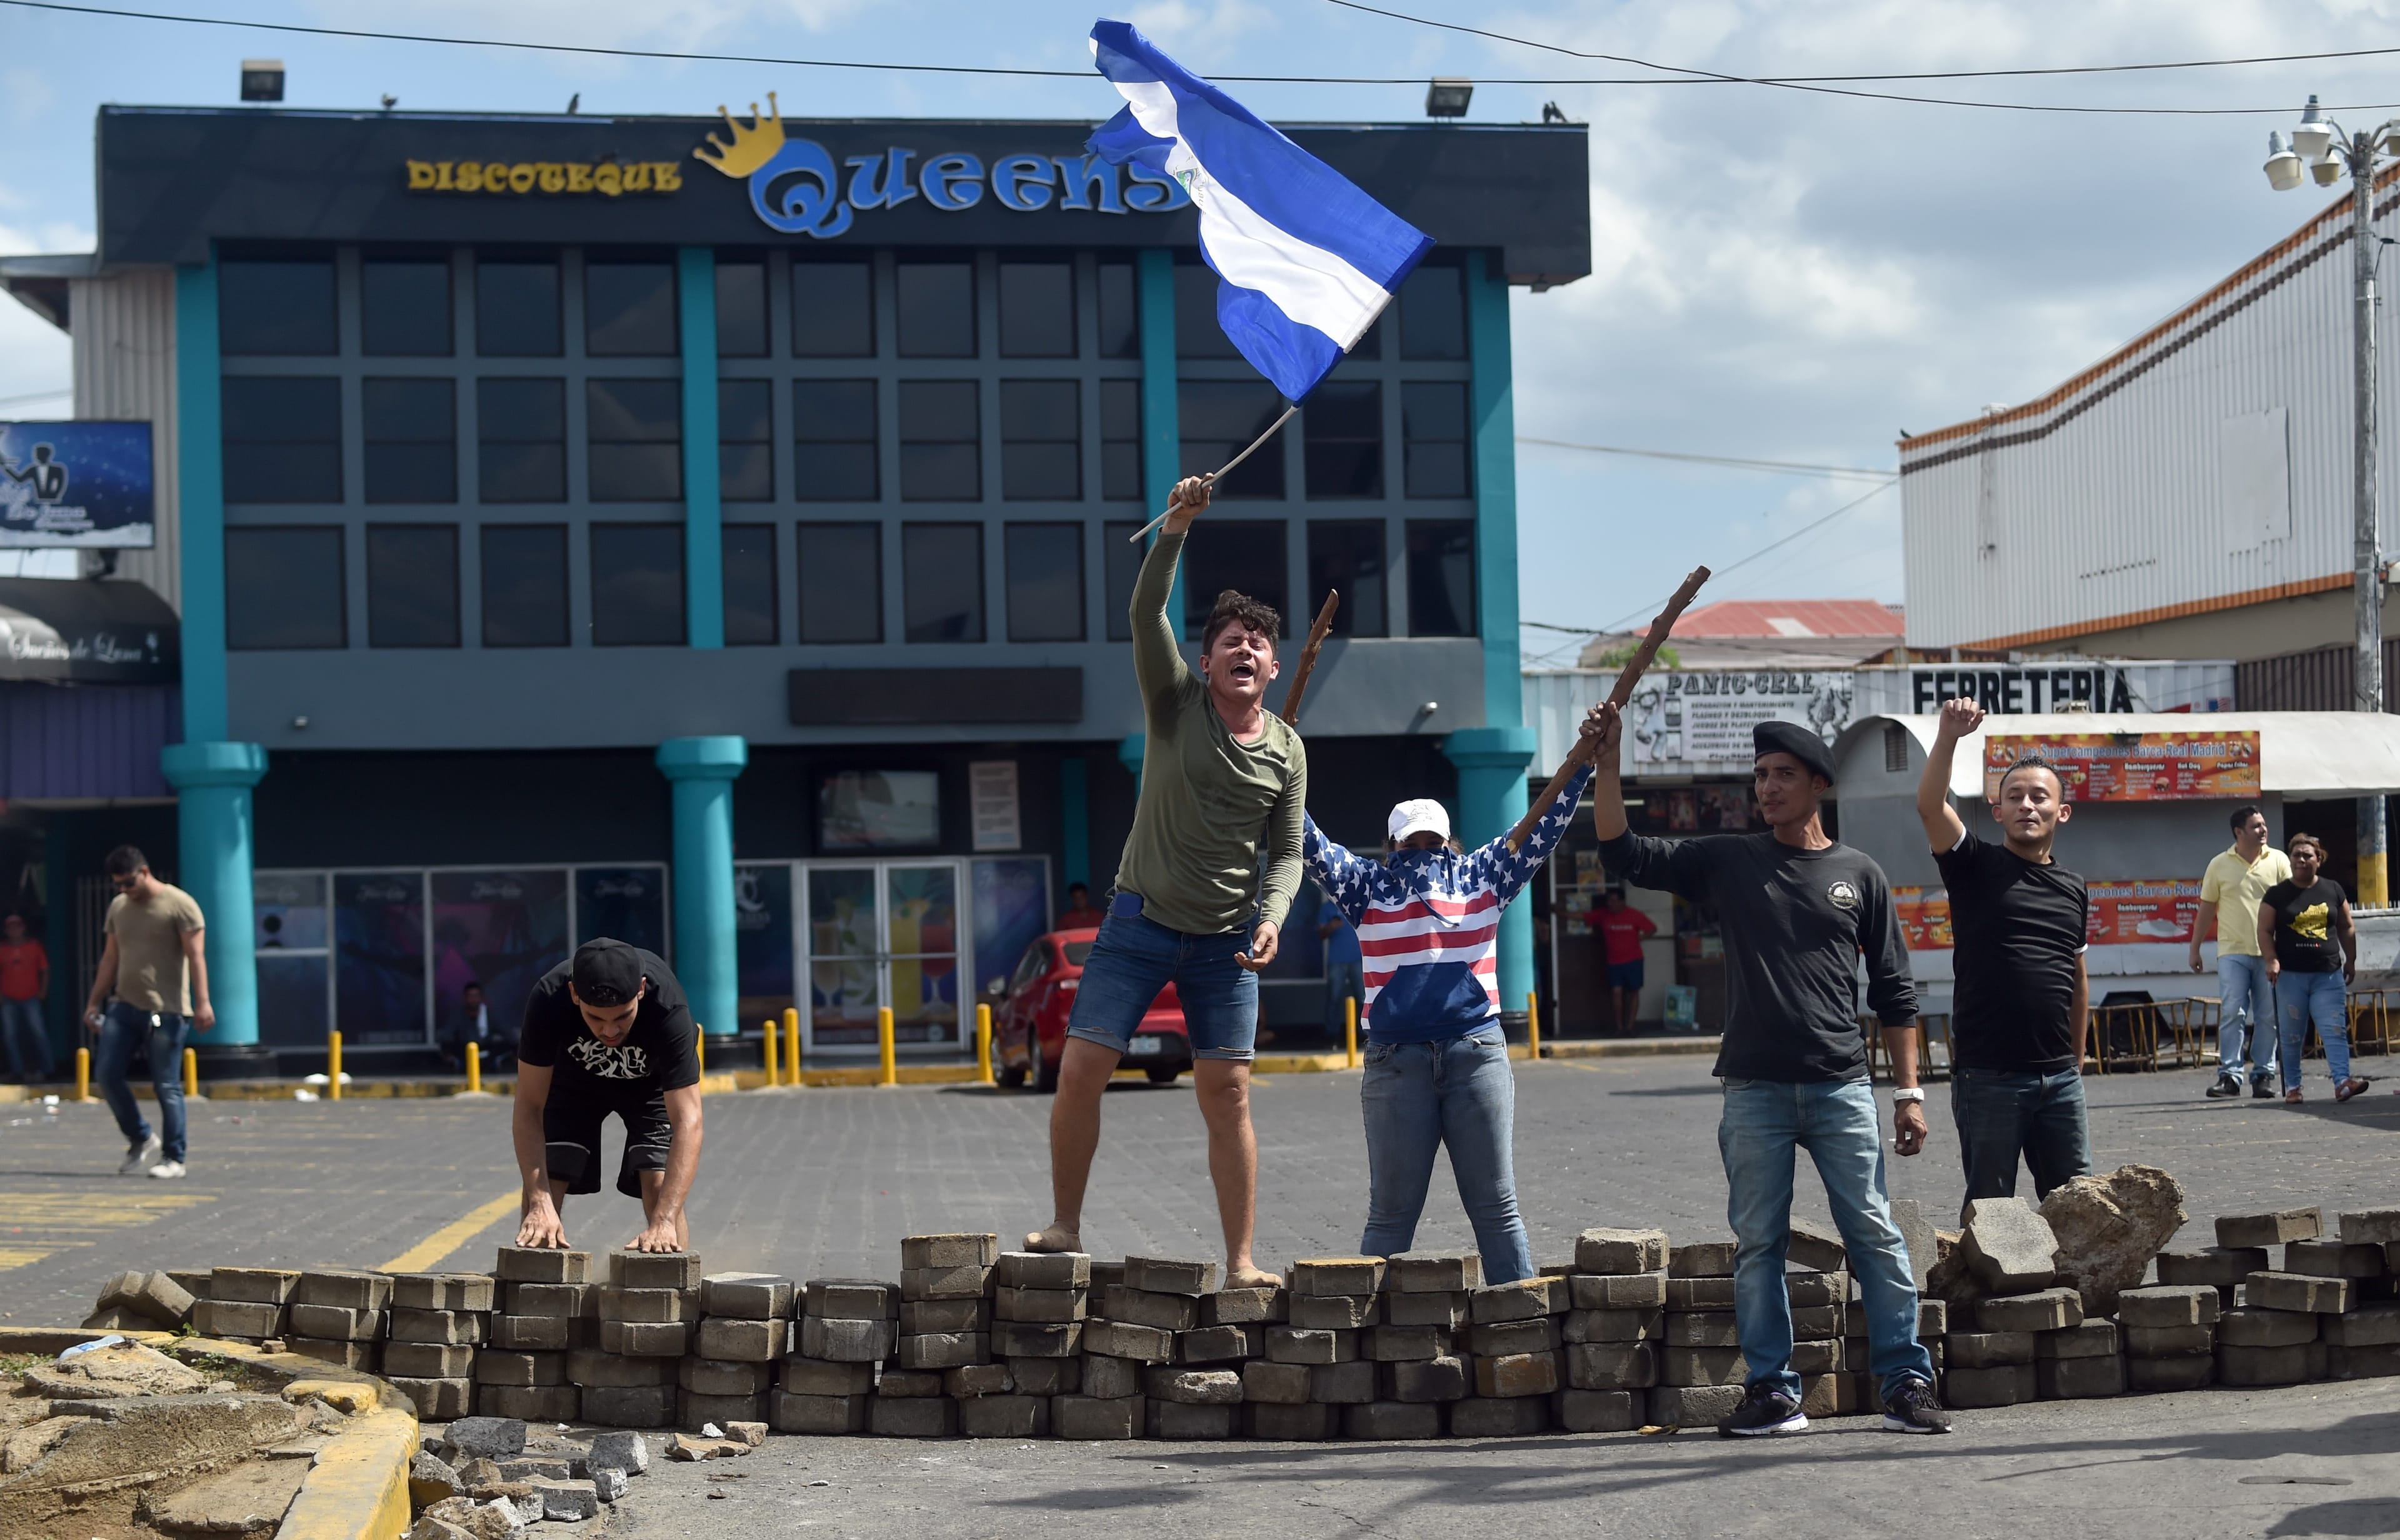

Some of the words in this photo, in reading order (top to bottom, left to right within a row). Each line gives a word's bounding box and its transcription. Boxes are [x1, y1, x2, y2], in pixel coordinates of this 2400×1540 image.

[406, 159, 682, 196] DISCOTEQUE
[749, 138, 1191, 239] Queens
[1912, 670, 2134, 714] FERRETERIA
[2190, 742, 2226, 757] Madrid
